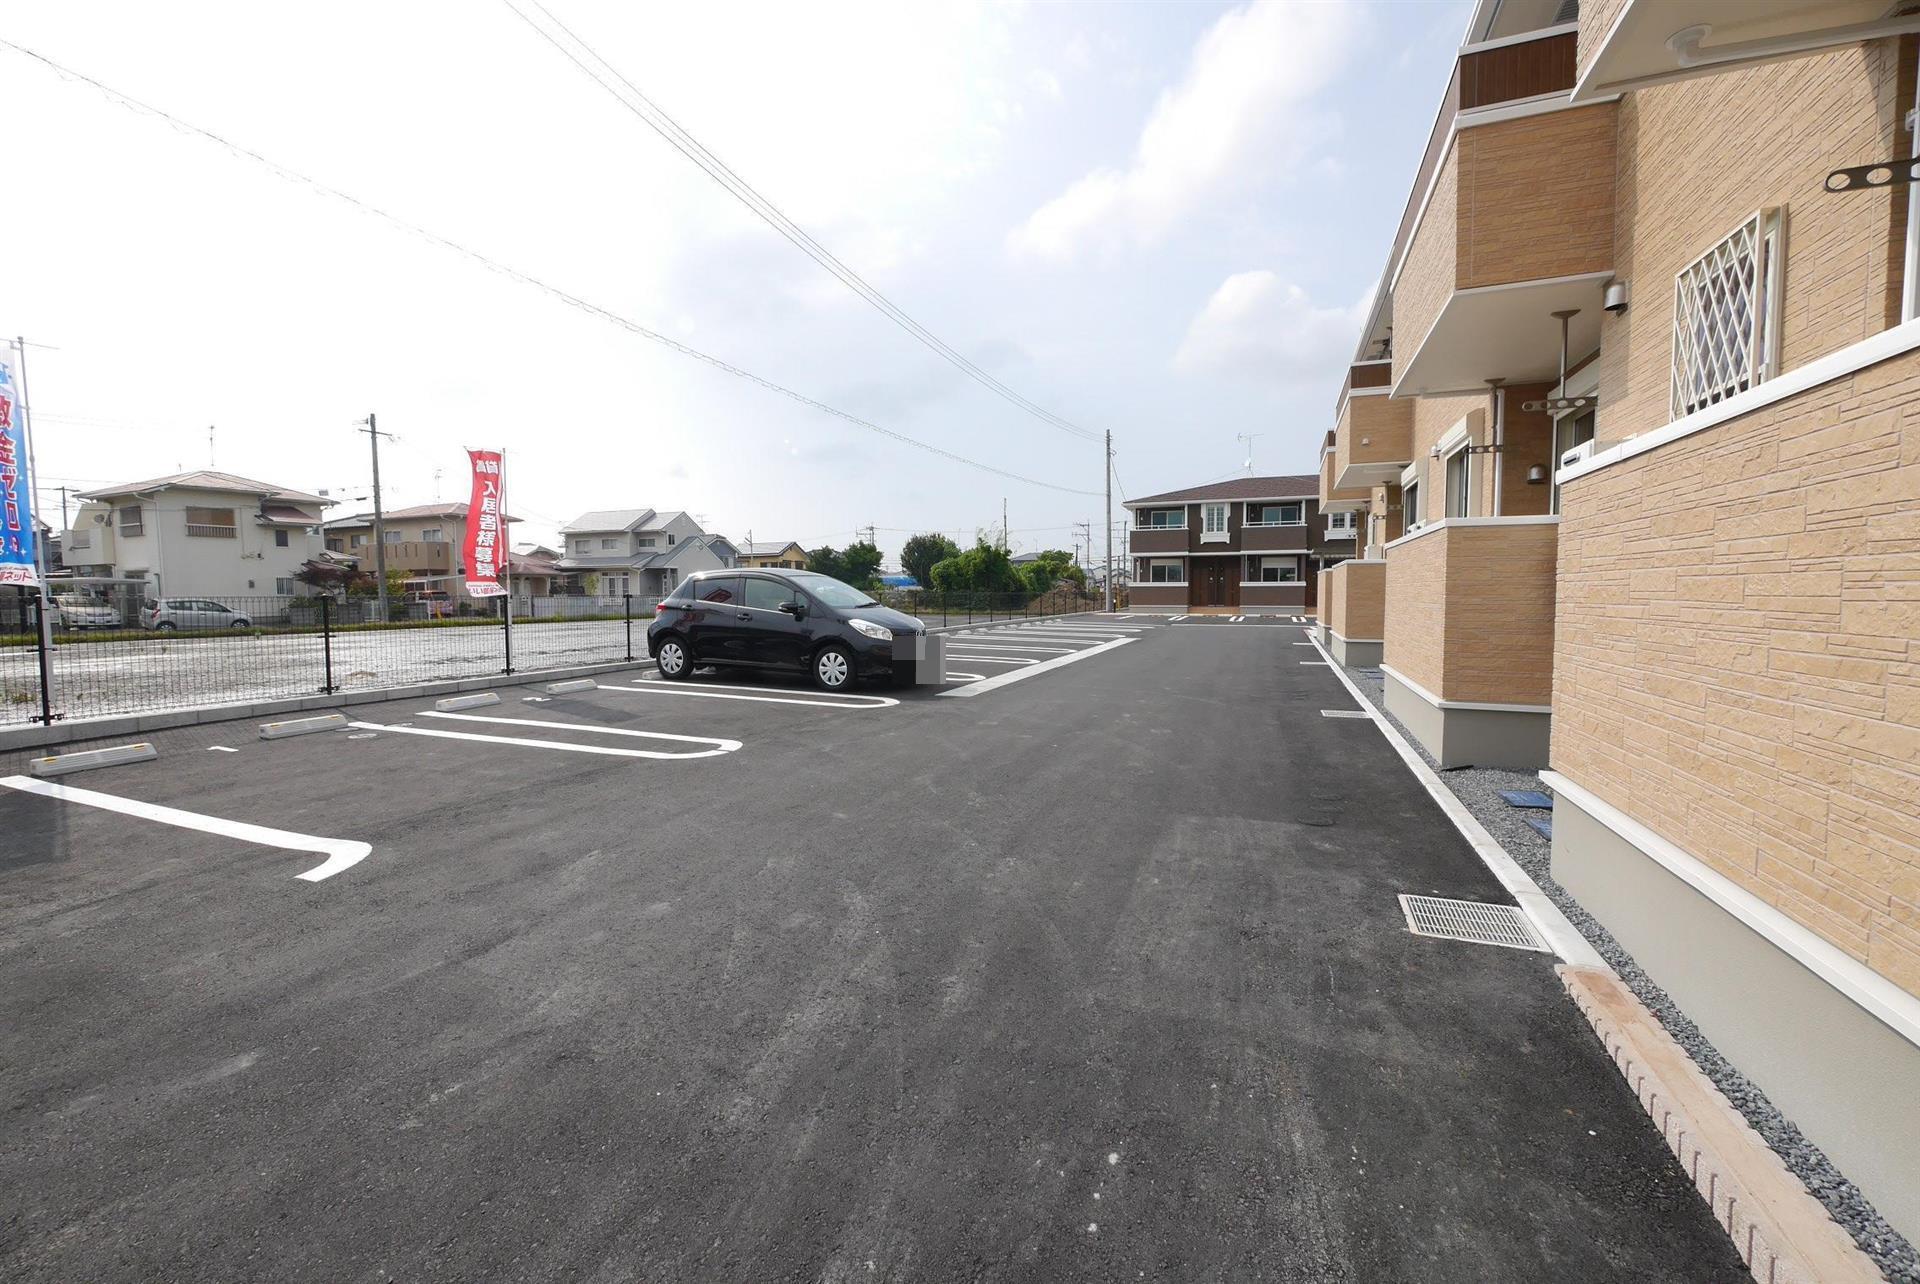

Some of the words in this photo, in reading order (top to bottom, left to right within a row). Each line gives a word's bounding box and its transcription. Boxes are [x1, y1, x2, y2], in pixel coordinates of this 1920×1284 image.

[475, 480, 497, 577] 入居者様募集
